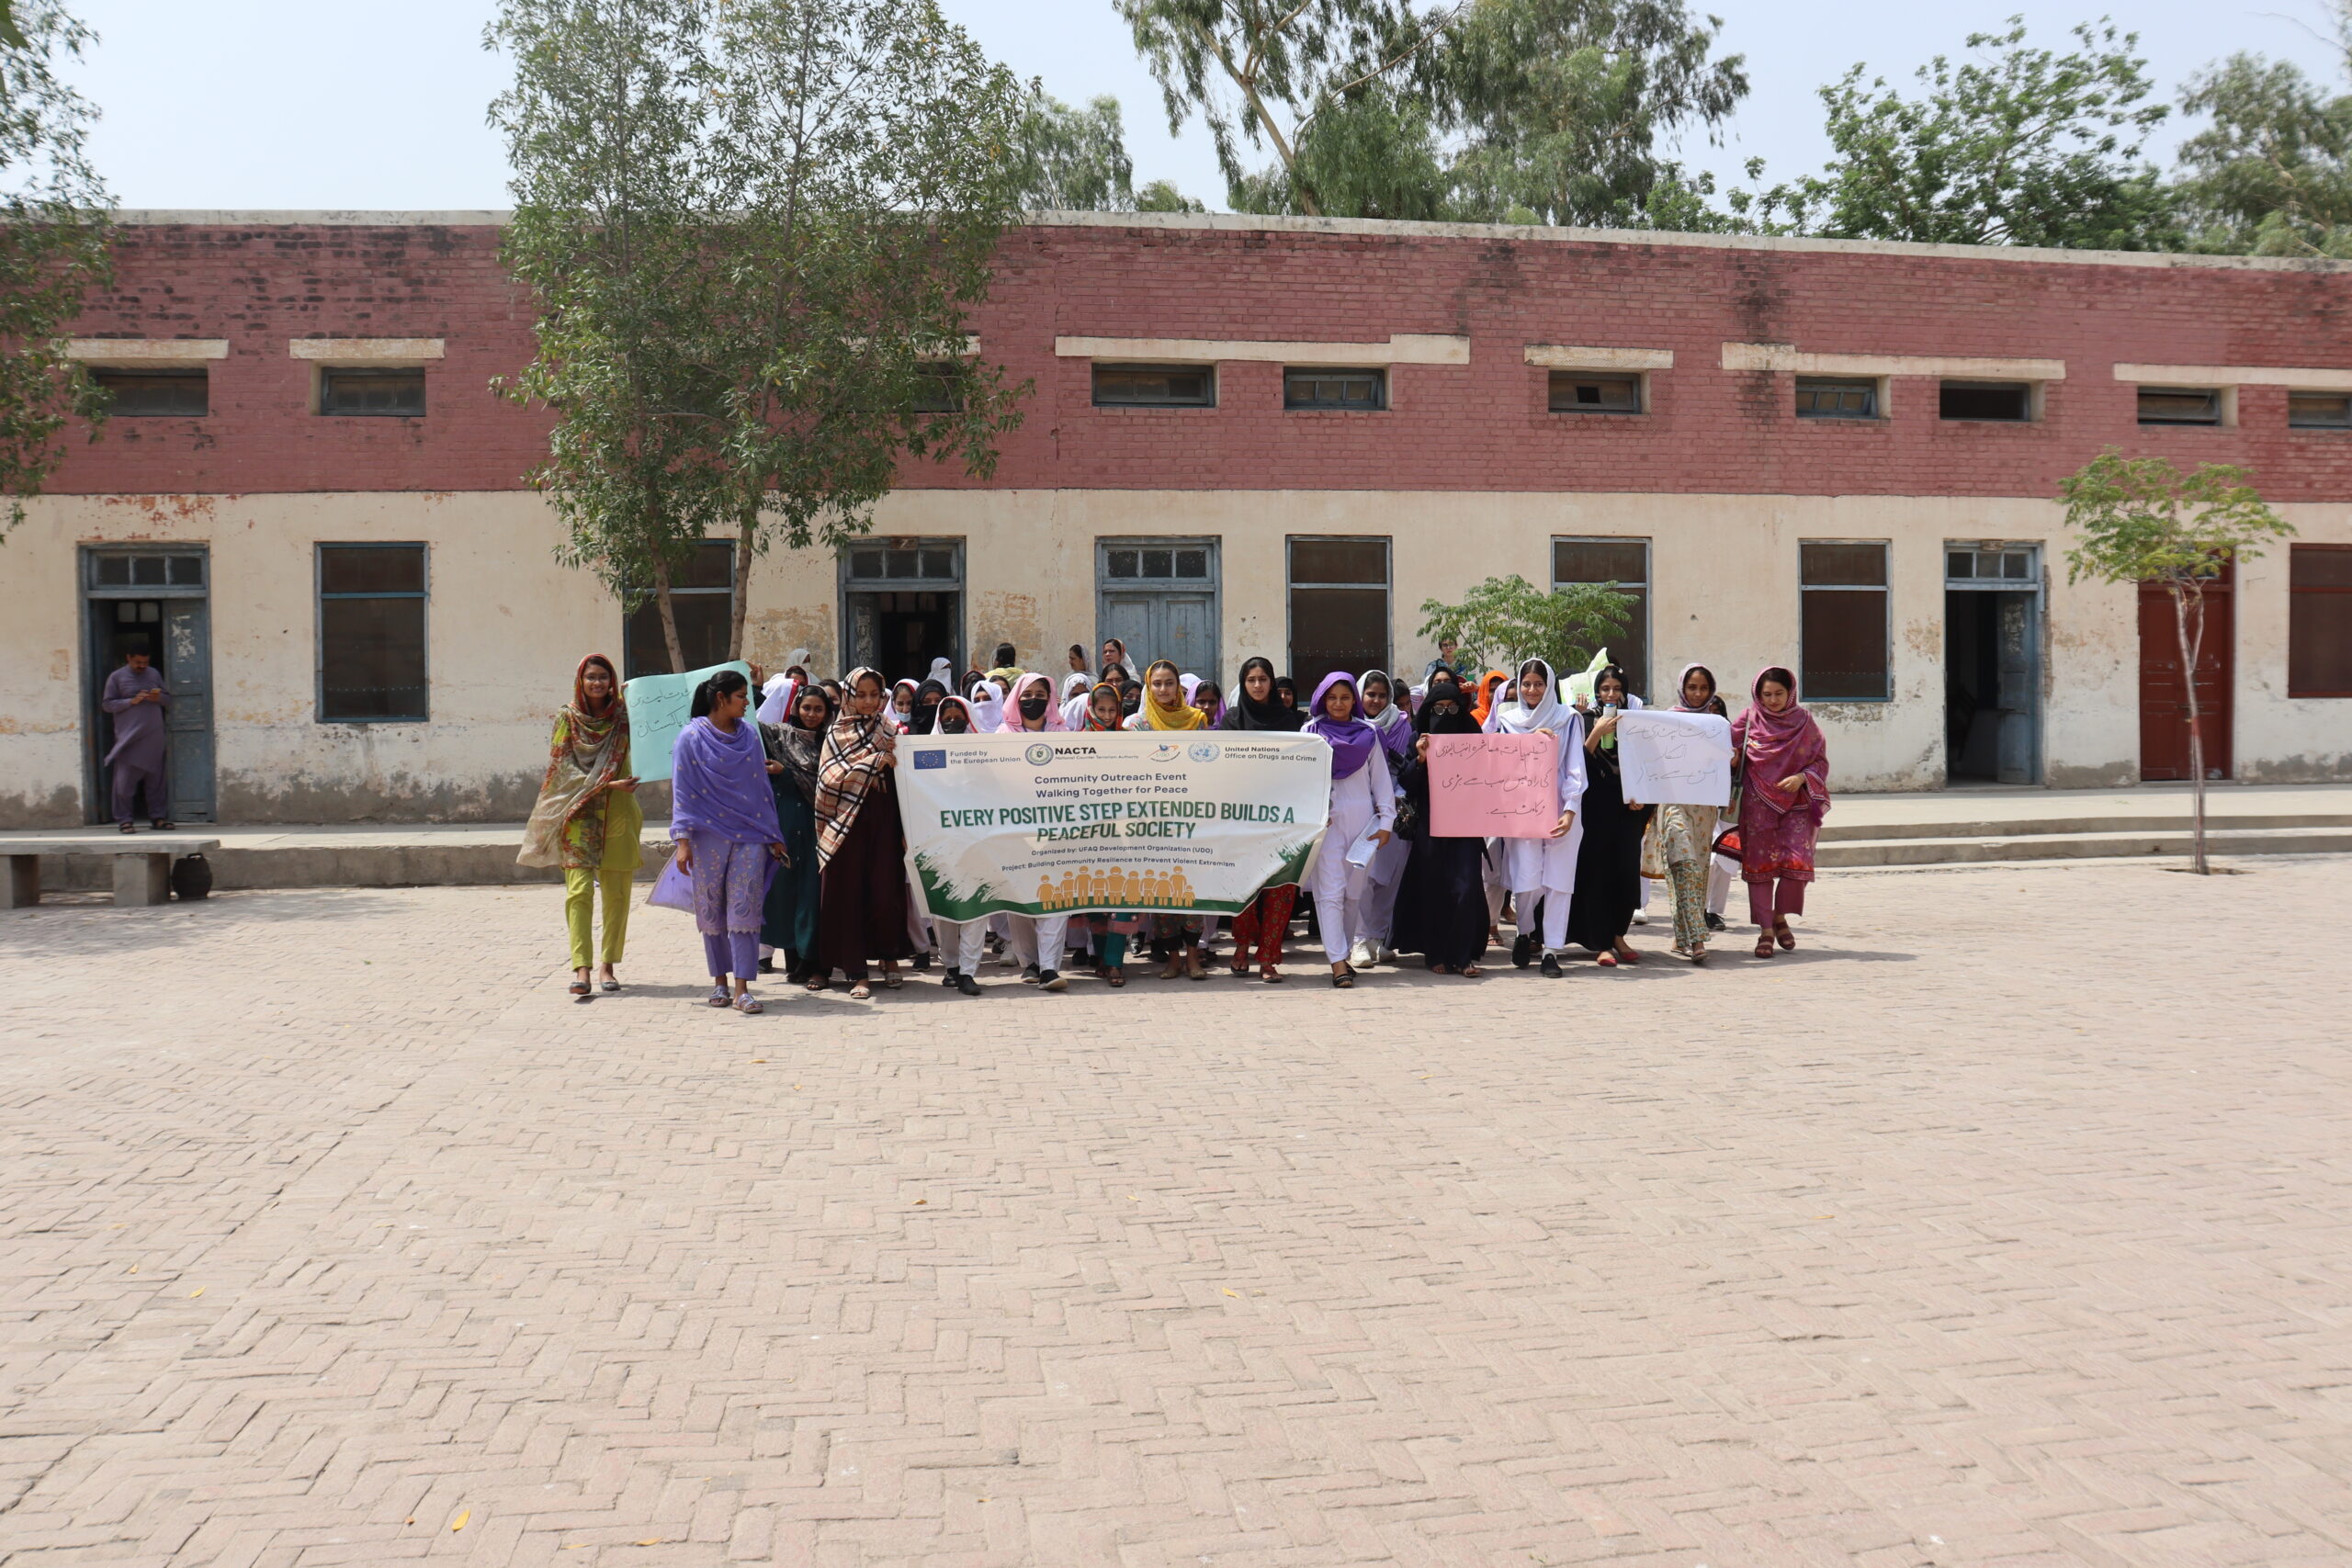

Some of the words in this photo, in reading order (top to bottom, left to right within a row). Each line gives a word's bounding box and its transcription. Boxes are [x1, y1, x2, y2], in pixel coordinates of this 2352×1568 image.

[637, 705, 686, 739] پاکستان
[1055, 747, 1097, 755] NACTA
[1035, 774, 1098, 784] Community
[1102, 773, 1152, 782] Outreach
[1660, 770, 1692, 780] سے
[1687, 765, 1718, 786] امن
[1036, 789, 1080, 798] Walking
[1082, 787, 1133, 796] Together
[1154, 785, 1188, 794] Peace
[940, 808, 994, 828] EVERY
[1000, 805, 1076, 825] POSITIVE
[1080, 802, 1123, 820] STEP
[1126, 801, 1216, 818] EXTENDED
[1220, 803, 1280, 823] BUILDS
[1283, 807, 1295, 823] A
[1036, 823, 1121, 841] PEACEFUL
[1125, 821, 1196, 839] SOCIETY
[1056, 858, 1095, 866] Community
